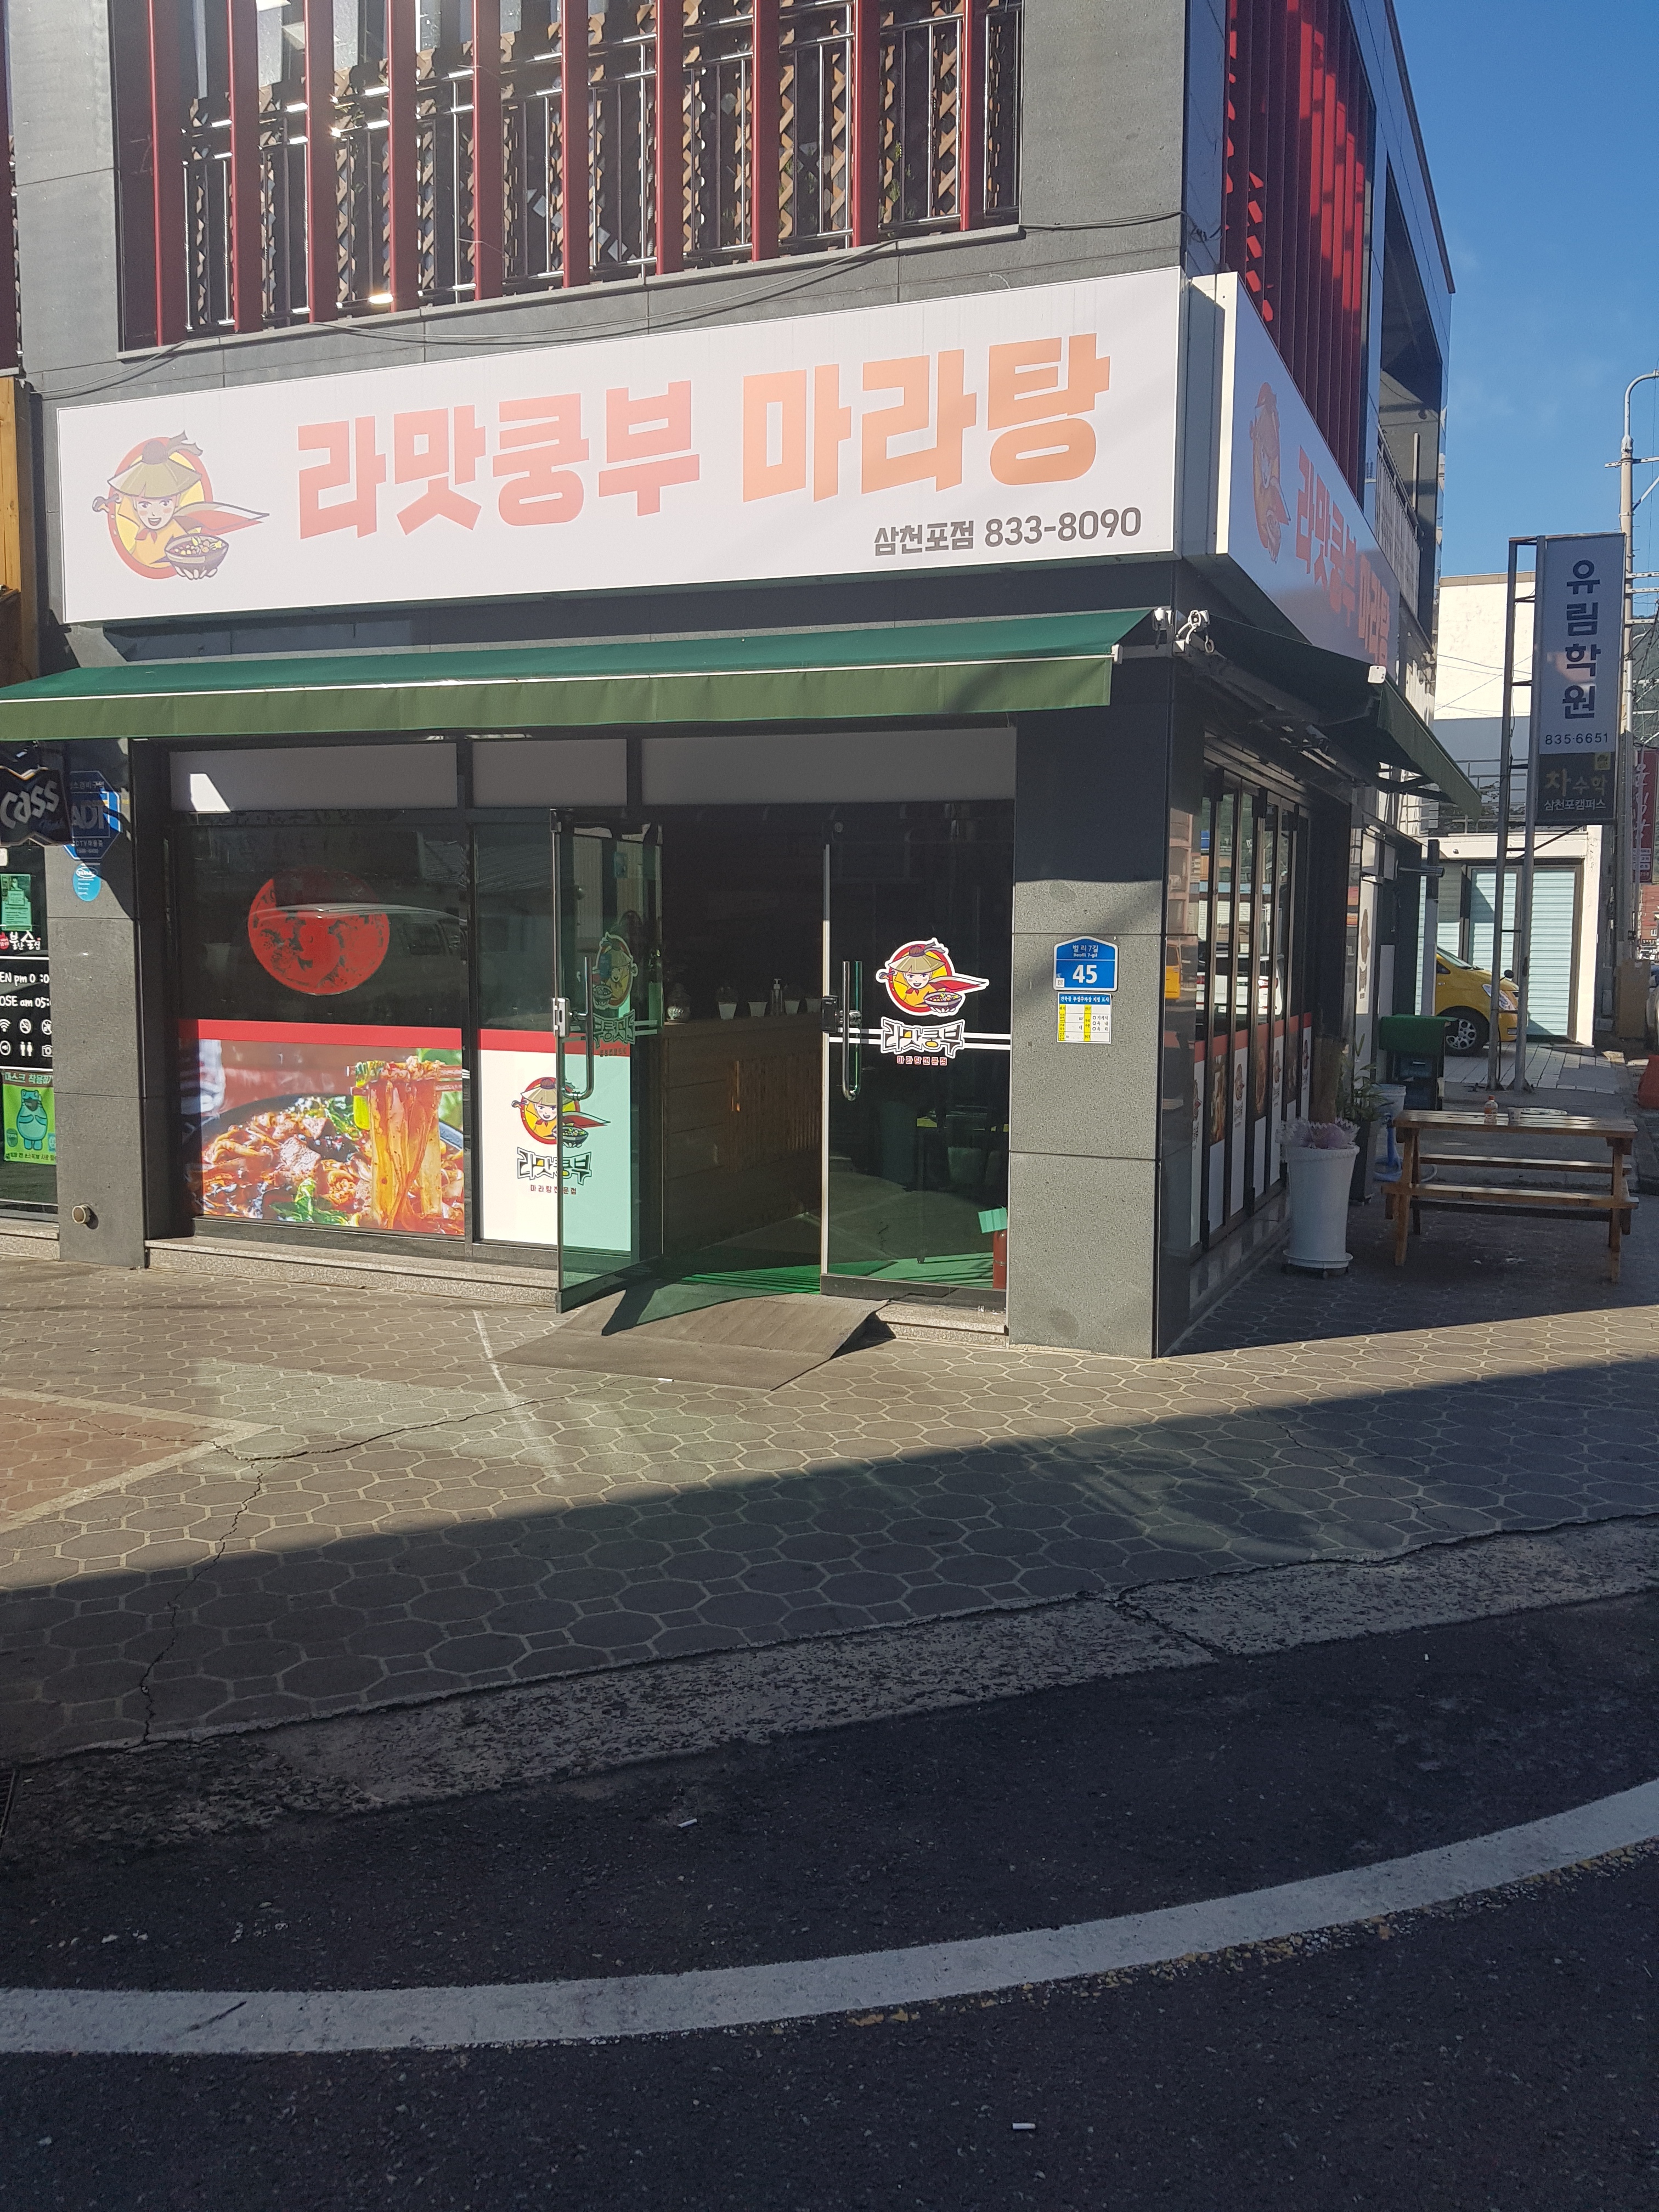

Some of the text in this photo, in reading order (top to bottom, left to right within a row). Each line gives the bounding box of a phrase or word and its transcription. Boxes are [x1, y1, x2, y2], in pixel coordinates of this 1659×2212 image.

[298, 333, 1110, 542] 라맛쿵부 마라탕
[874, 507, 1141, 556] 삼천포점 833-8090
[1296, 444, 1357, 628] 라맛쿵부
[1561, 560, 1601, 719] 유림학원
[71, 800, 105, 830] ADT
[1544, 798, 1606, 811] 삼천포캠퍼스
[9, 930, 41, 951] 불난술집
[14, 975, 27, 986] pm
[1073, 964, 1097, 984] 45
[35, 997, 52, 1008] 05:
[881, 1015, 966, 1059] 라맛쿵부
[897, 1056, 947, 1065] 마라탕전문점
[4, 1071, 26, 1083] 마스크
